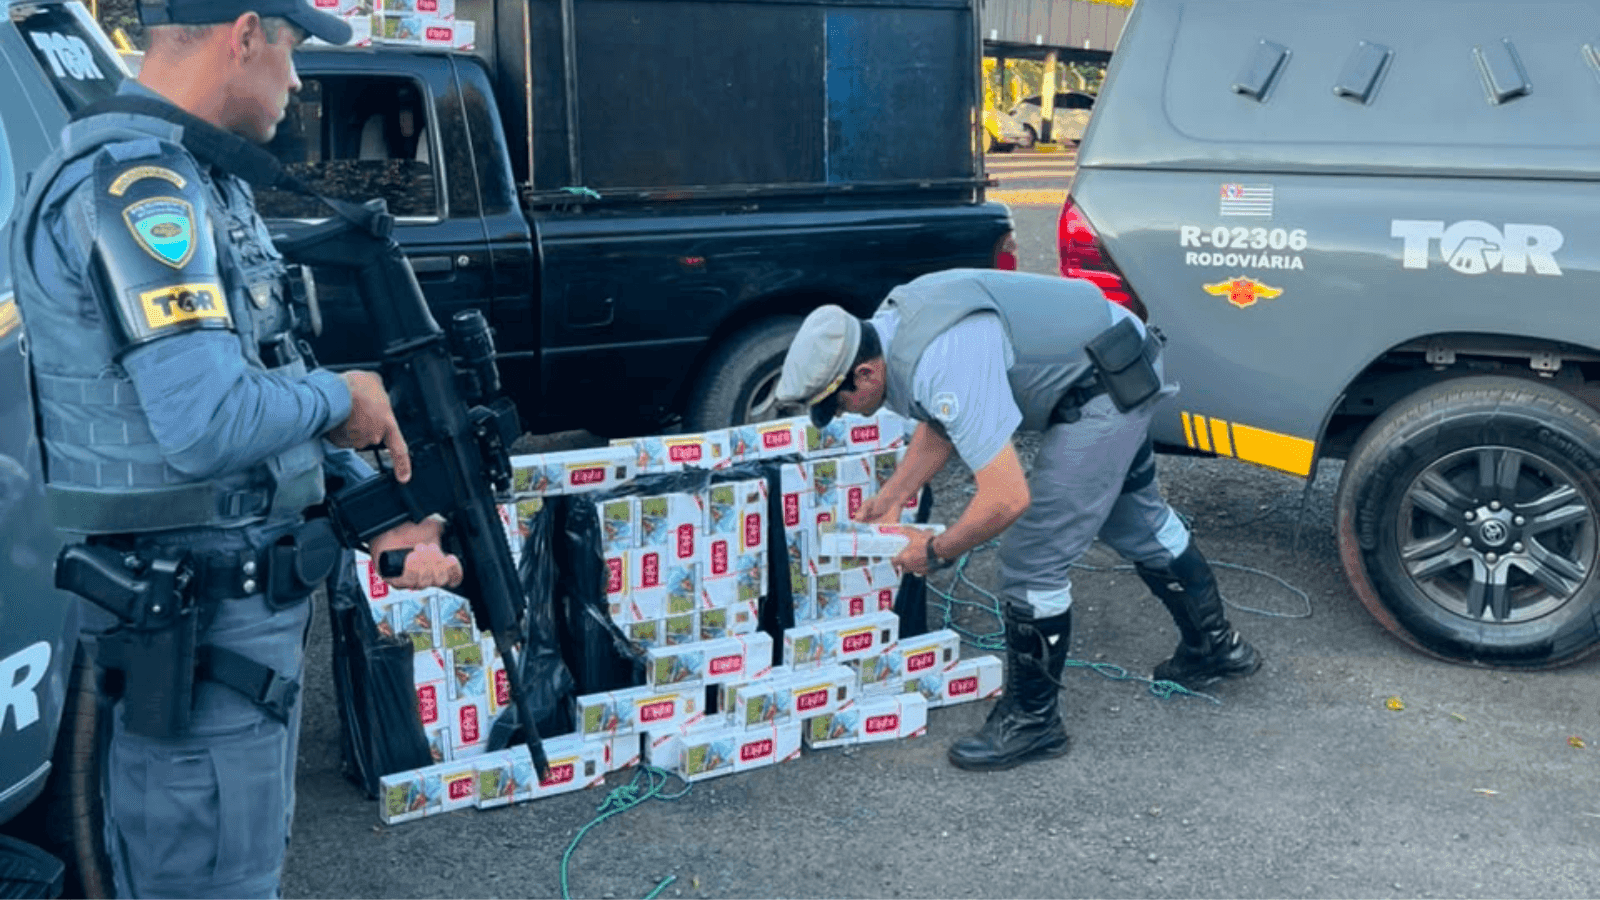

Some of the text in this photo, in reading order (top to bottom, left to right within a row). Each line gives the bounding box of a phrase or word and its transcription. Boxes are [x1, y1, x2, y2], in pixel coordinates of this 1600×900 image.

[30, 31, 104, 80] TOR
[1180, 226, 1307, 251] R-02306
[1391, 219, 1563, 276] TOR
[1186, 251, 1304, 270] RODOVIÁRIA
[152, 289, 217, 317] TOR
